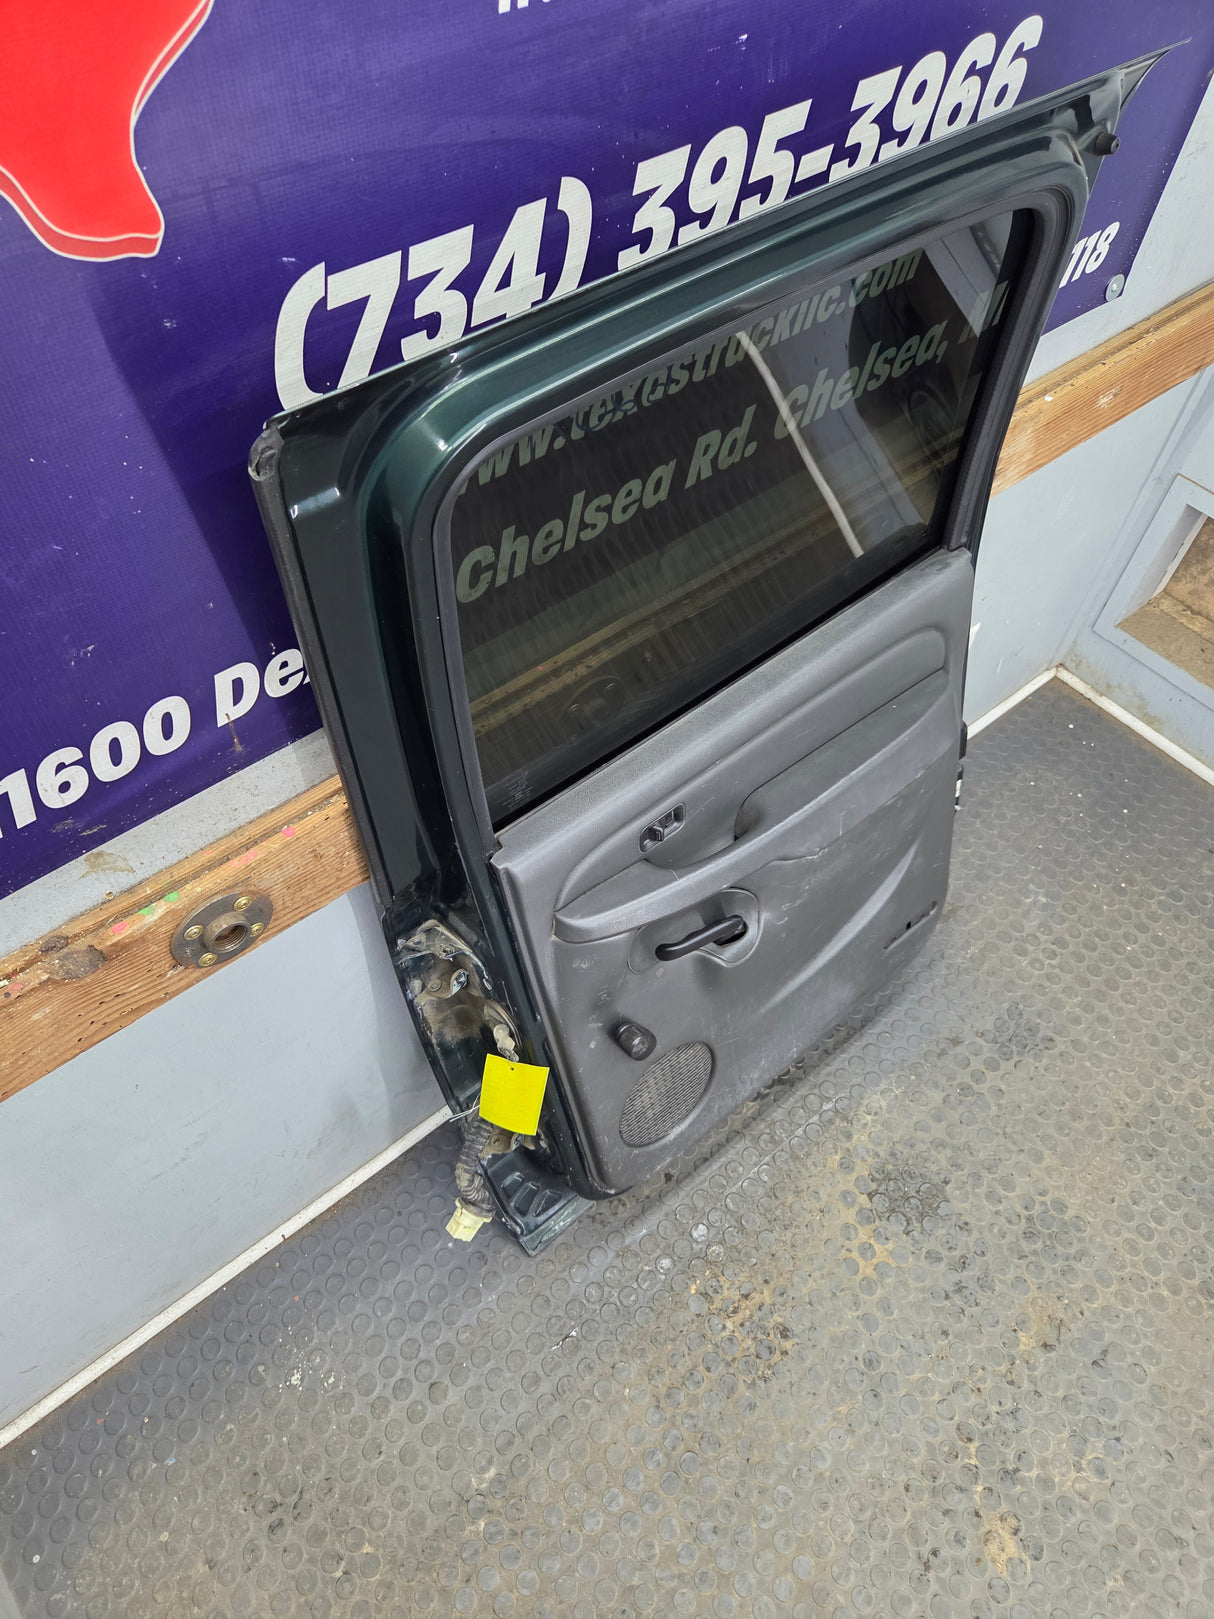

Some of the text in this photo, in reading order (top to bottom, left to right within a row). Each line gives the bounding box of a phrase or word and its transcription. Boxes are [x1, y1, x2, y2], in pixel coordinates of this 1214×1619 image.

[274, 15, 1044, 411] (734) 395-3966
[458, 246, 926, 496] ww.texastruckllc.com
[0, 696, 192, 839] 1600
[213, 648, 311, 728] De
[455, 458, 677, 603] Chelsea
[684, 403, 758, 490] Rd.
[773, 318, 949, 440] Chelsea,
